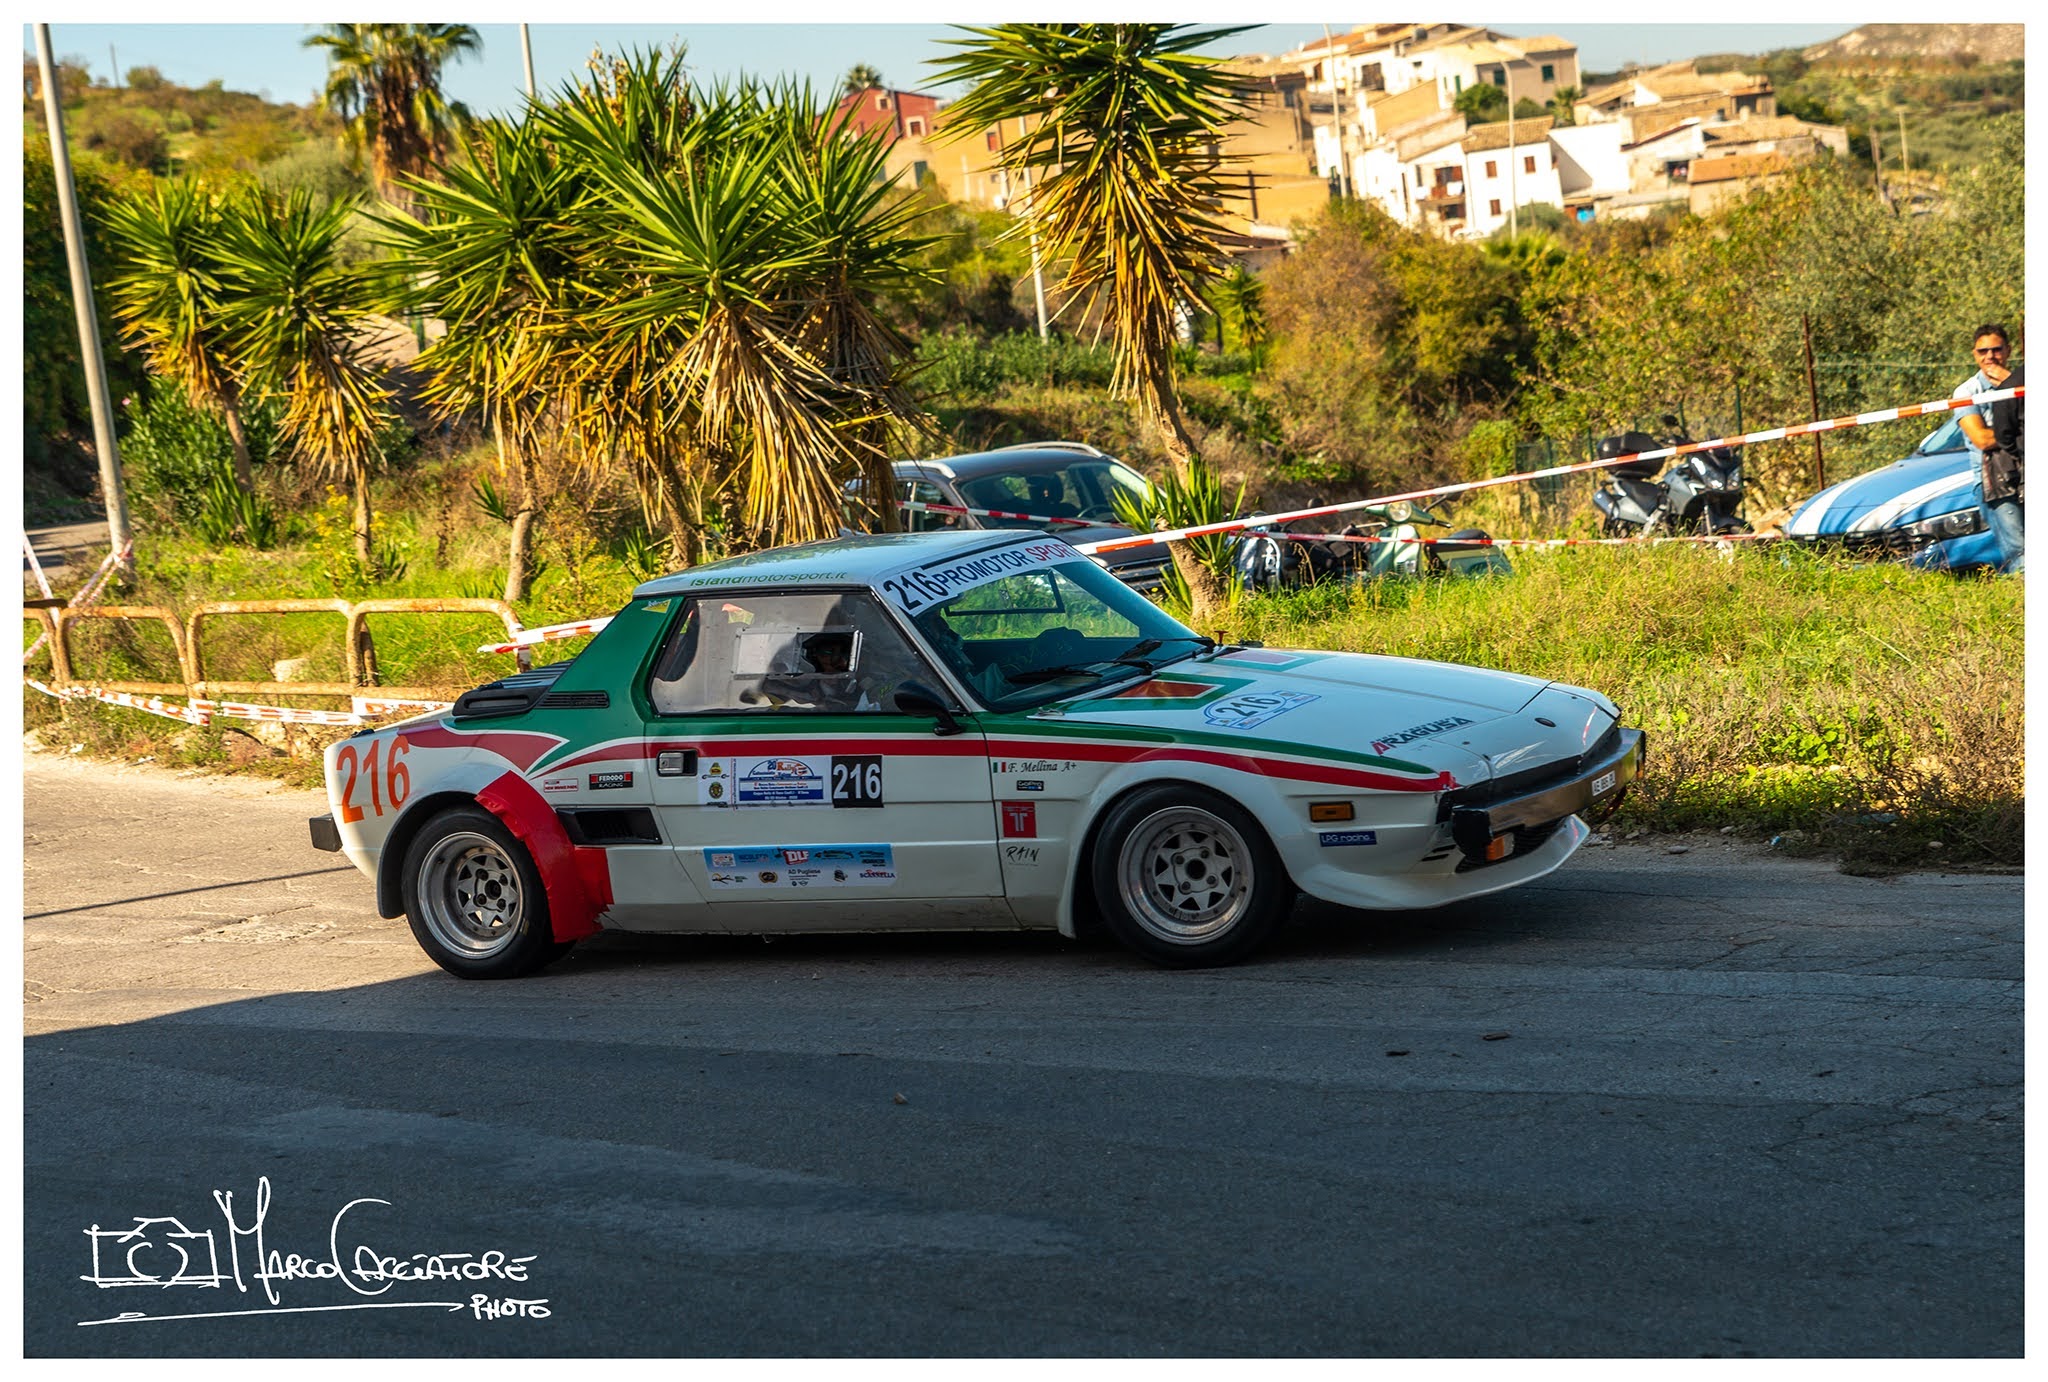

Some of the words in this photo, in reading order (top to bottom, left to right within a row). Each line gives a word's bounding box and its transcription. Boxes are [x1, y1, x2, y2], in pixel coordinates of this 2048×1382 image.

[883, 571, 950, 611] 216
[932, 550, 1035, 589] PROMOTOR
[1214, 696, 1281, 717] 216
[335, 734, 411, 824] 216
[598, 774, 624, 782] FERODO
[1022, 760, 1058, 773] Mellina
[833, 763, 881, 800] 216
